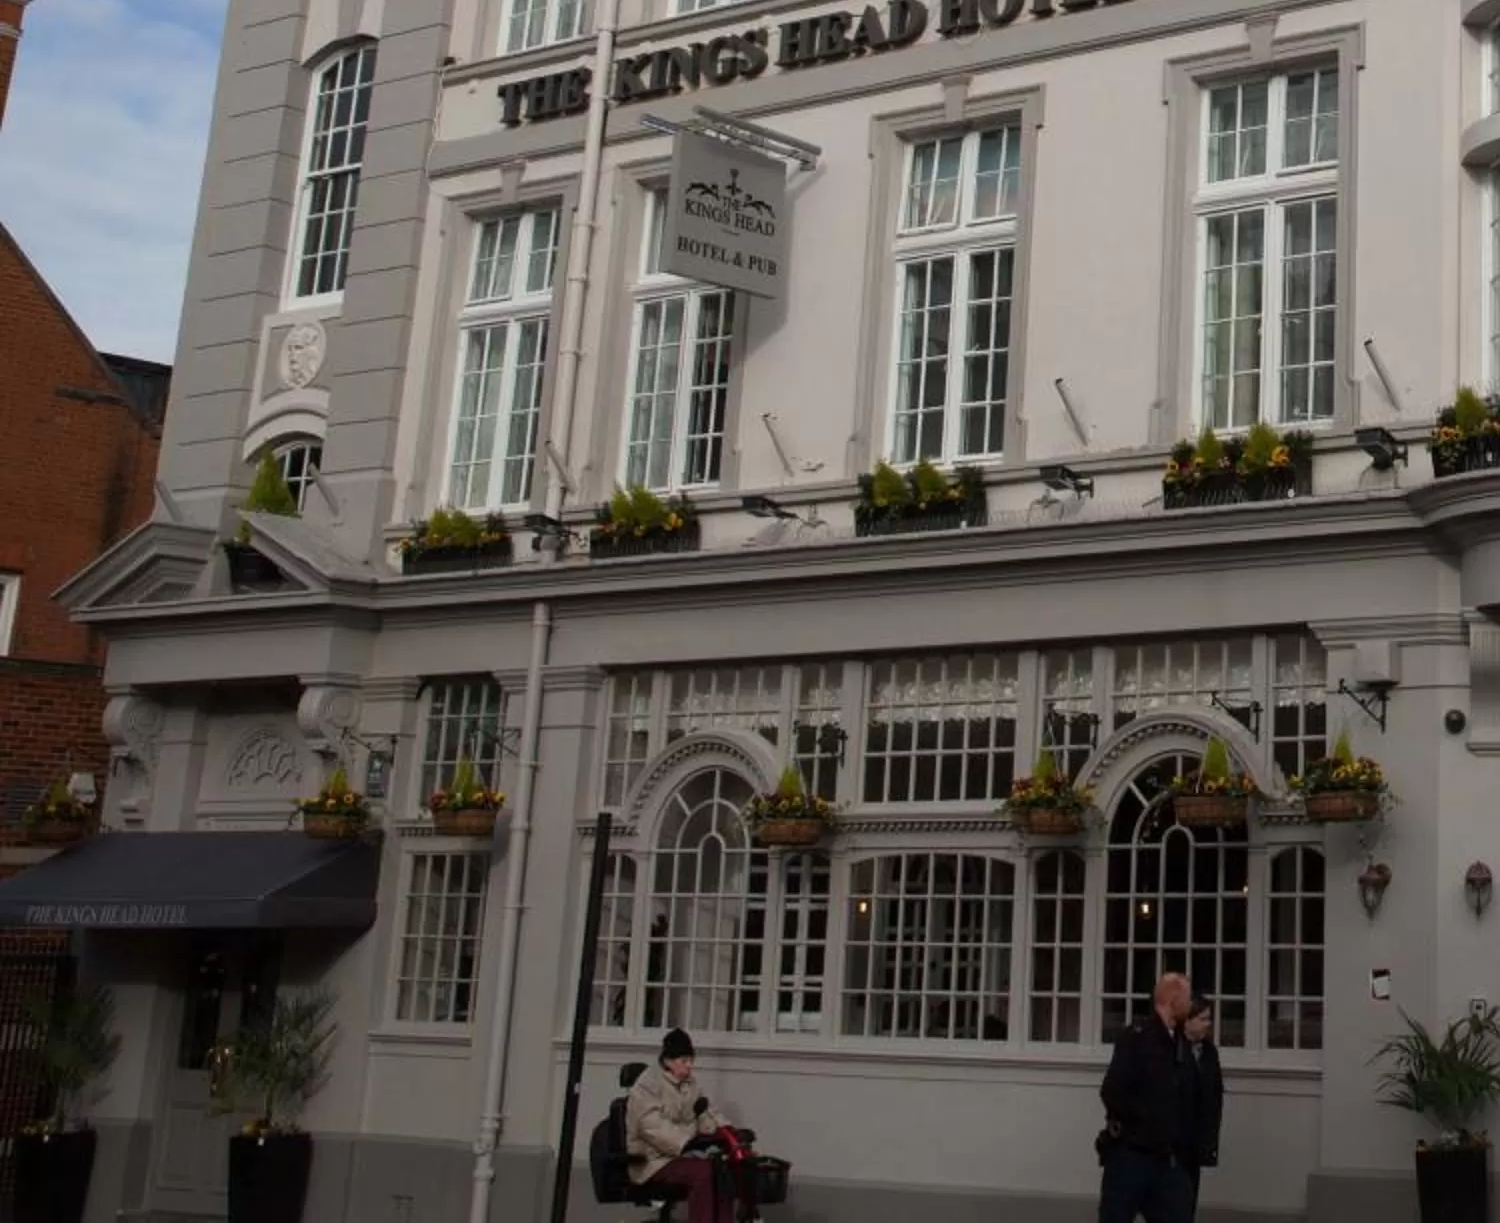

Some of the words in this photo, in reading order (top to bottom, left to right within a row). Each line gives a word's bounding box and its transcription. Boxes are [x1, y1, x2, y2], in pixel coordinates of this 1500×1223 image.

[498, 67, 592, 127] THE
[611, 27, 768, 104] KINGS
[685, 198, 730, 225] KINGS
[735, 213, 775, 237] HEAD
[677, 235, 729, 265] HOTEL
[733, 250, 743, 267] &
[748, 255, 777, 275] PUB
[26, 904, 54, 923] THE
[55, 904, 97, 923] KINGS
[100, 904, 138, 923] HEAD
[141, 904, 188, 923] HOTEL
